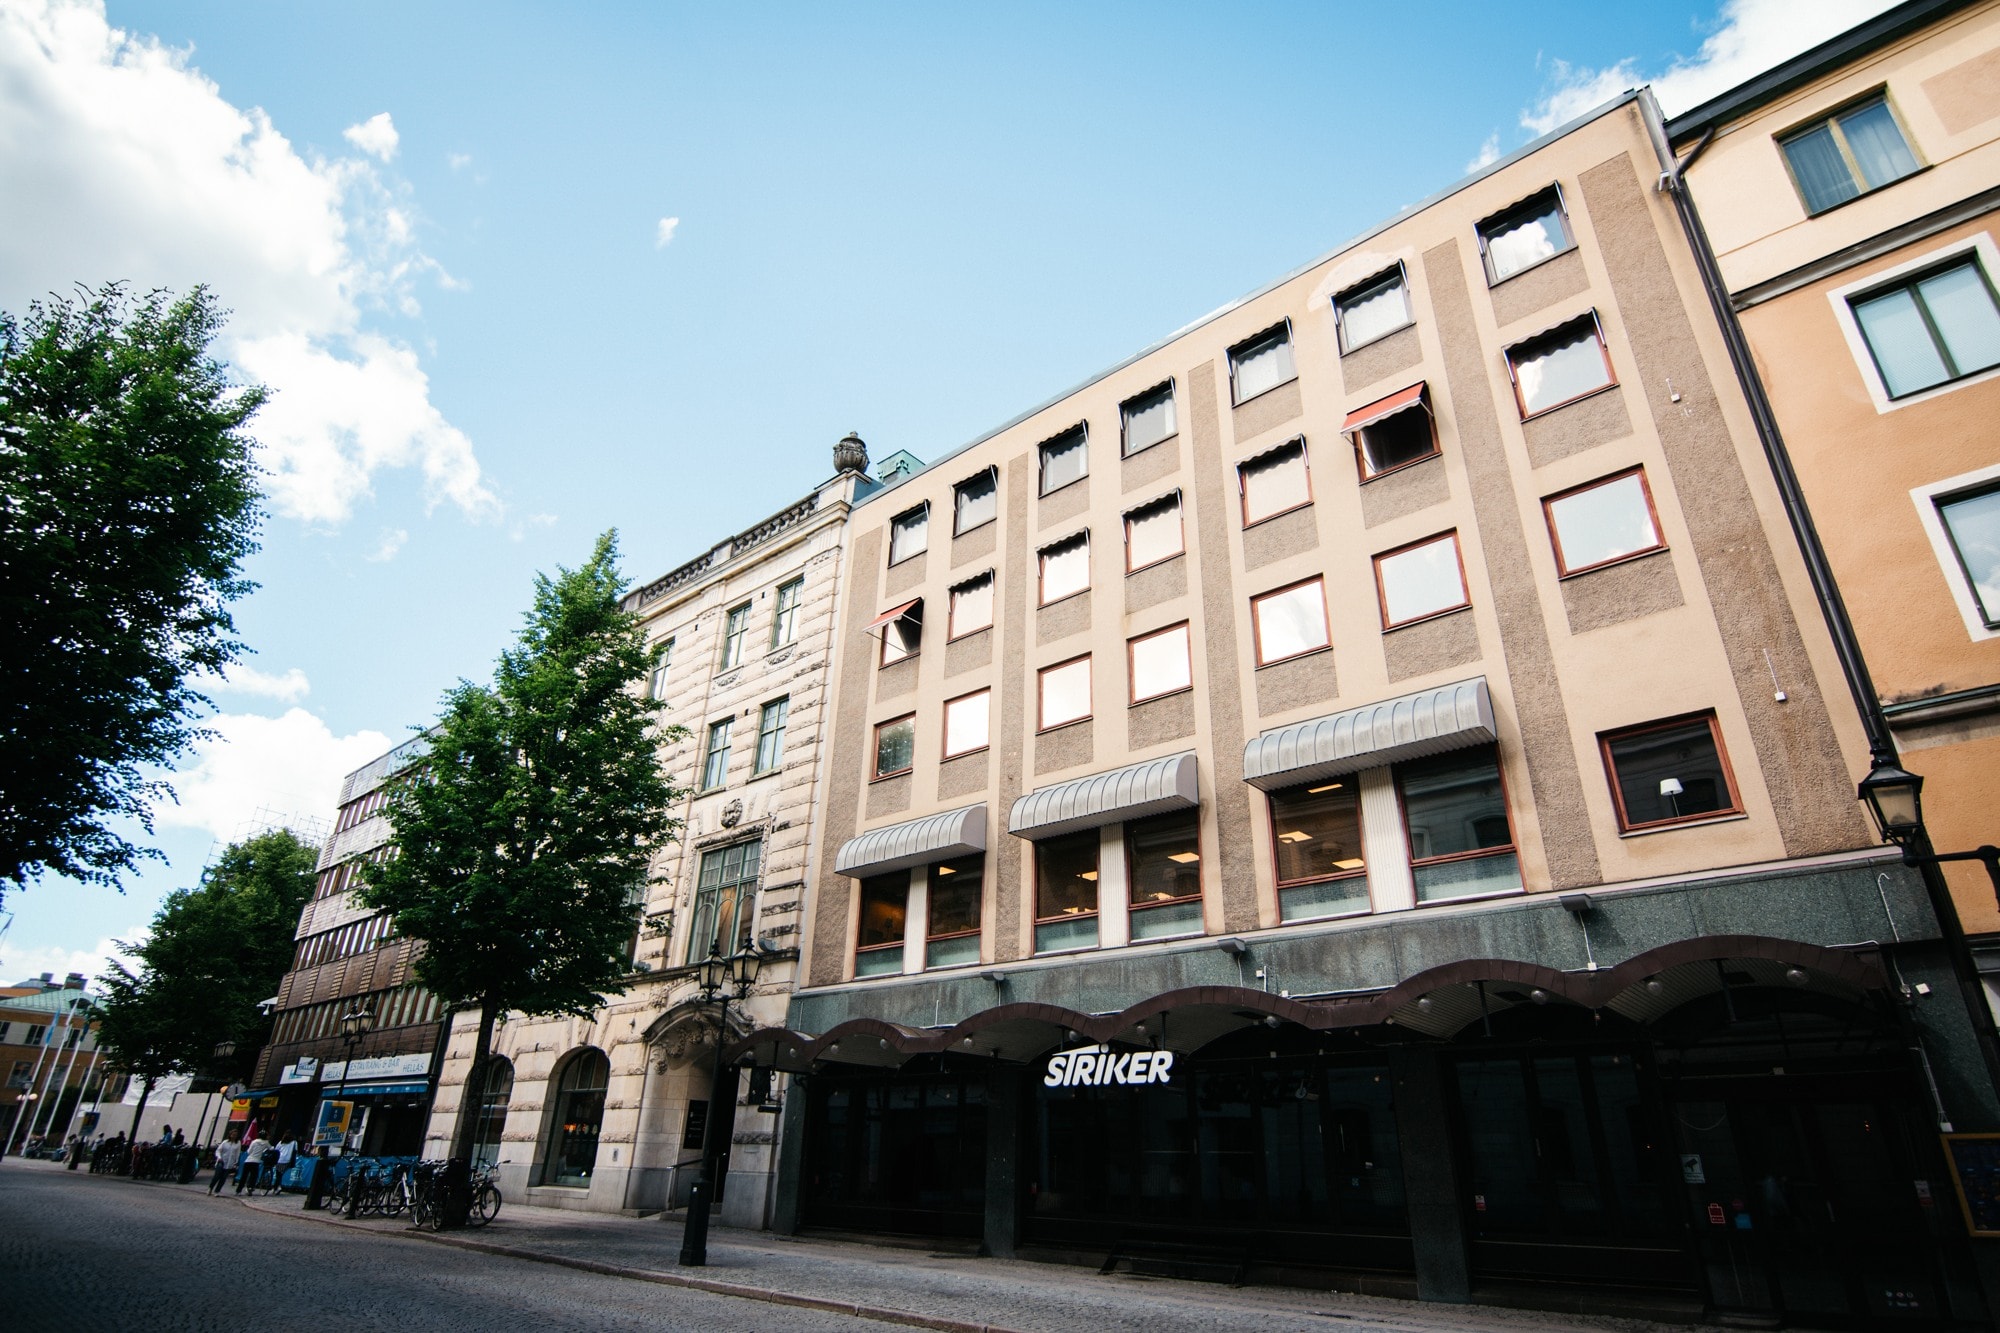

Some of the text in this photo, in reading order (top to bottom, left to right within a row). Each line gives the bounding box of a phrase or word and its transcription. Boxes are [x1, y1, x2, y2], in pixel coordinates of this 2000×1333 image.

[403, 1063, 424, 1073] HELLAS
[1044, 1044, 1173, 1087] STRIKER
[325, 1070, 341, 1079] HELLAS
